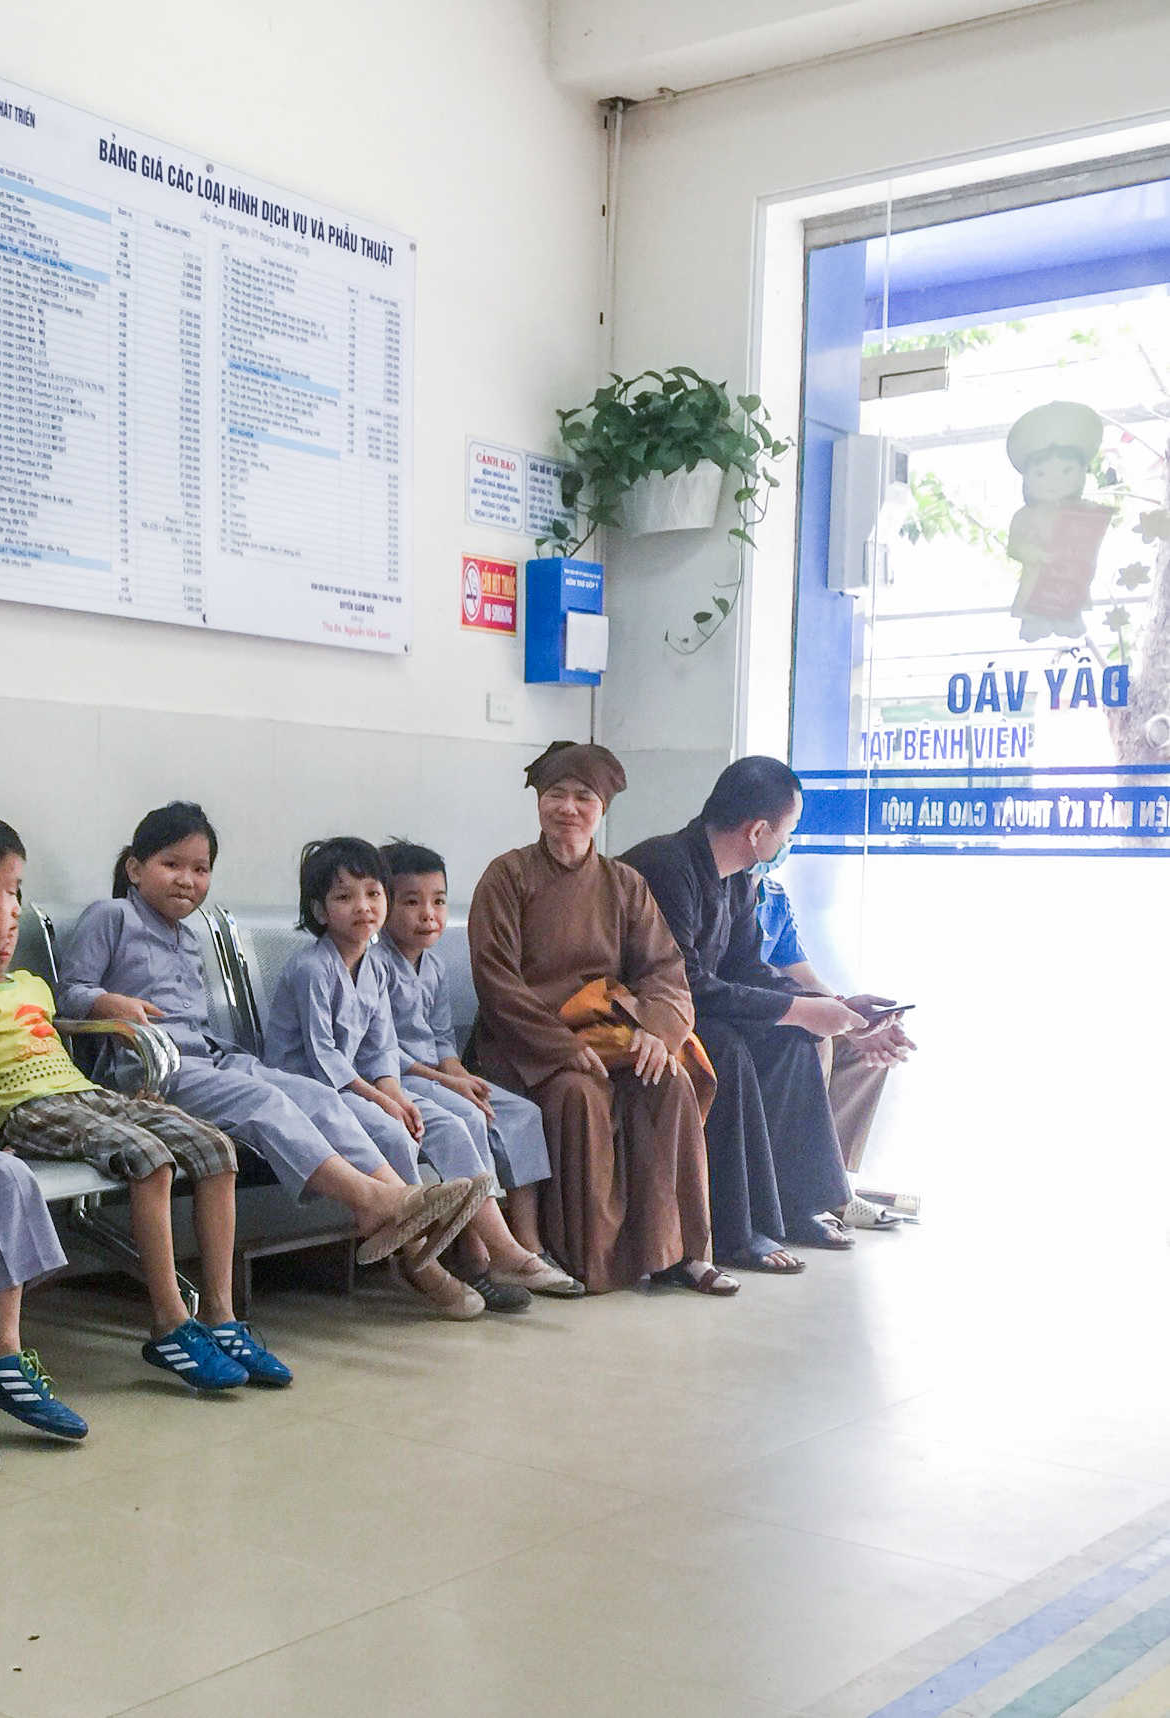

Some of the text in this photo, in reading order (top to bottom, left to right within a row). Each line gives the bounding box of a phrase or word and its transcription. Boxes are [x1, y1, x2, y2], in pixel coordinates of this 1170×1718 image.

[15, 104, 36, 128] TRIỂN
[98, 132, 395, 269] BẢNG GIÁ CÁC LOẠI HÌNH DỊCH VỤ VÀ PHẪU THUẬT
[476, 449, 516, 472] CẢNH BÁO
